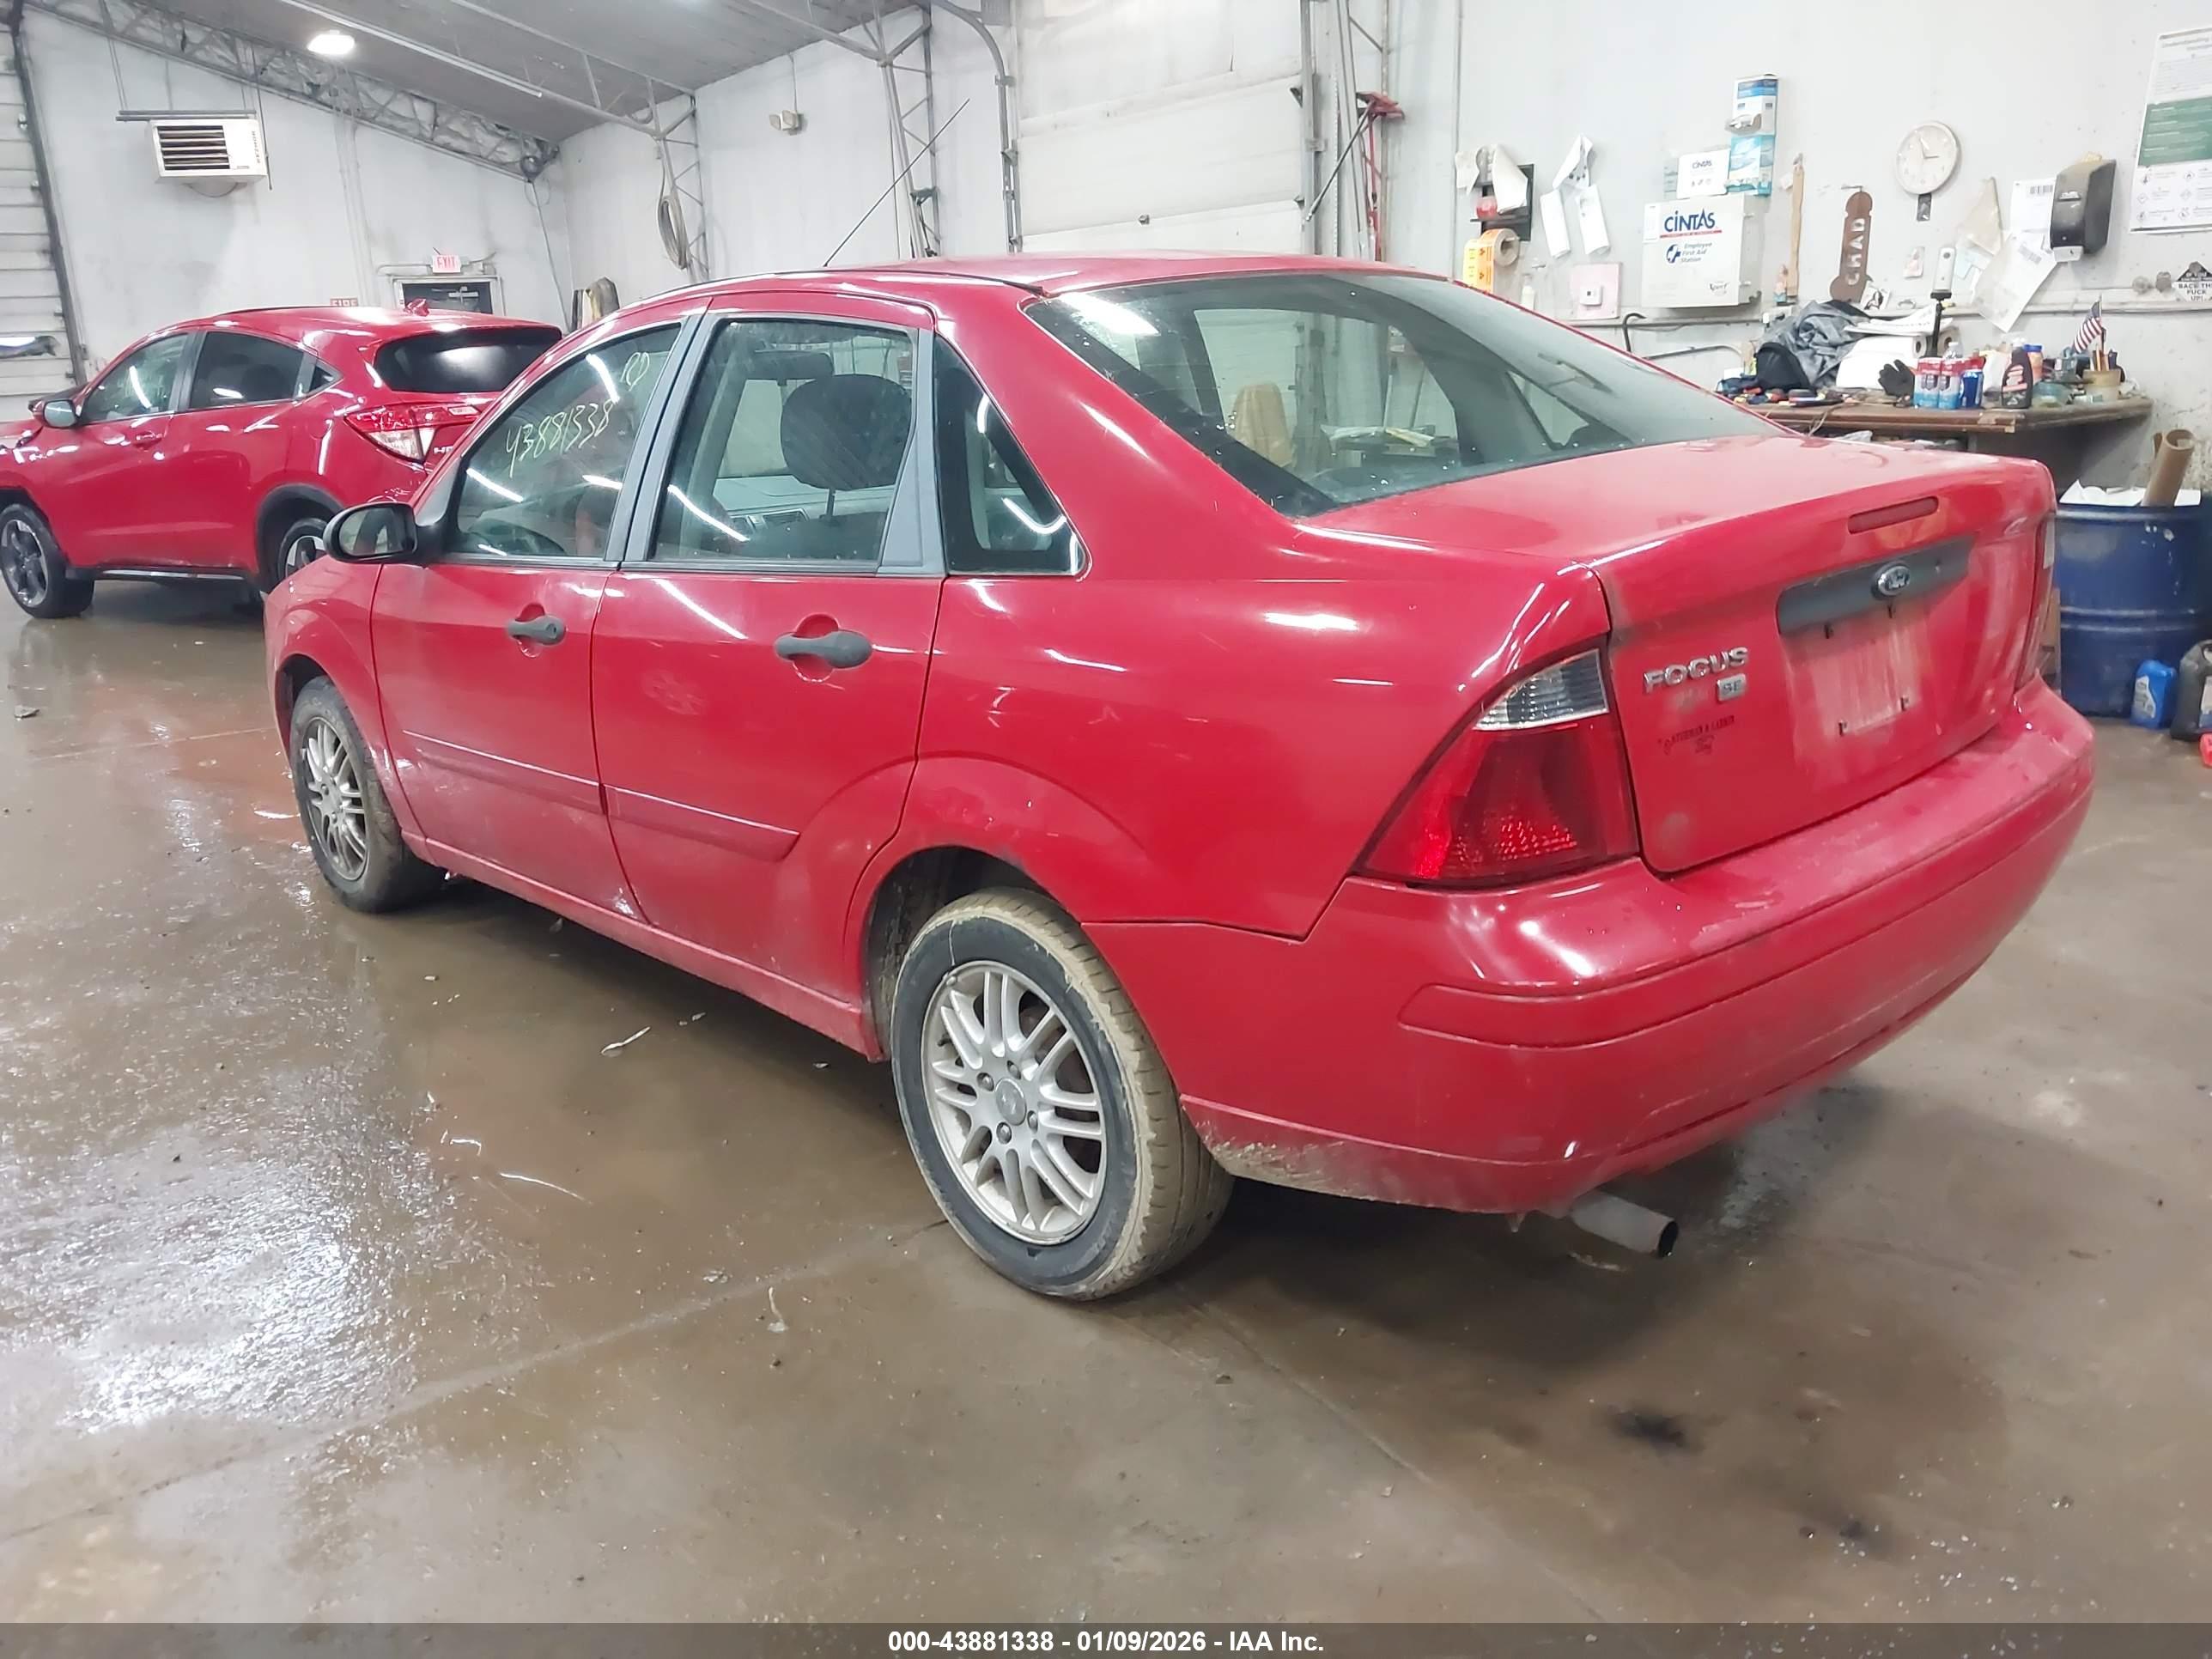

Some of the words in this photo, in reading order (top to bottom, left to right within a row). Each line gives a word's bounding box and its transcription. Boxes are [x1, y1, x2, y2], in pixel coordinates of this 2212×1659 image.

[1664, 208, 1716, 233] CINTAS
[436, 256, 456, 269] EXIT
[1844, 217, 1866, 286] CHAD
[506, 398, 614, 479] 43881338
[1644, 647, 1749, 694] FOCUS
[1723, 678, 1742, 695] SE
